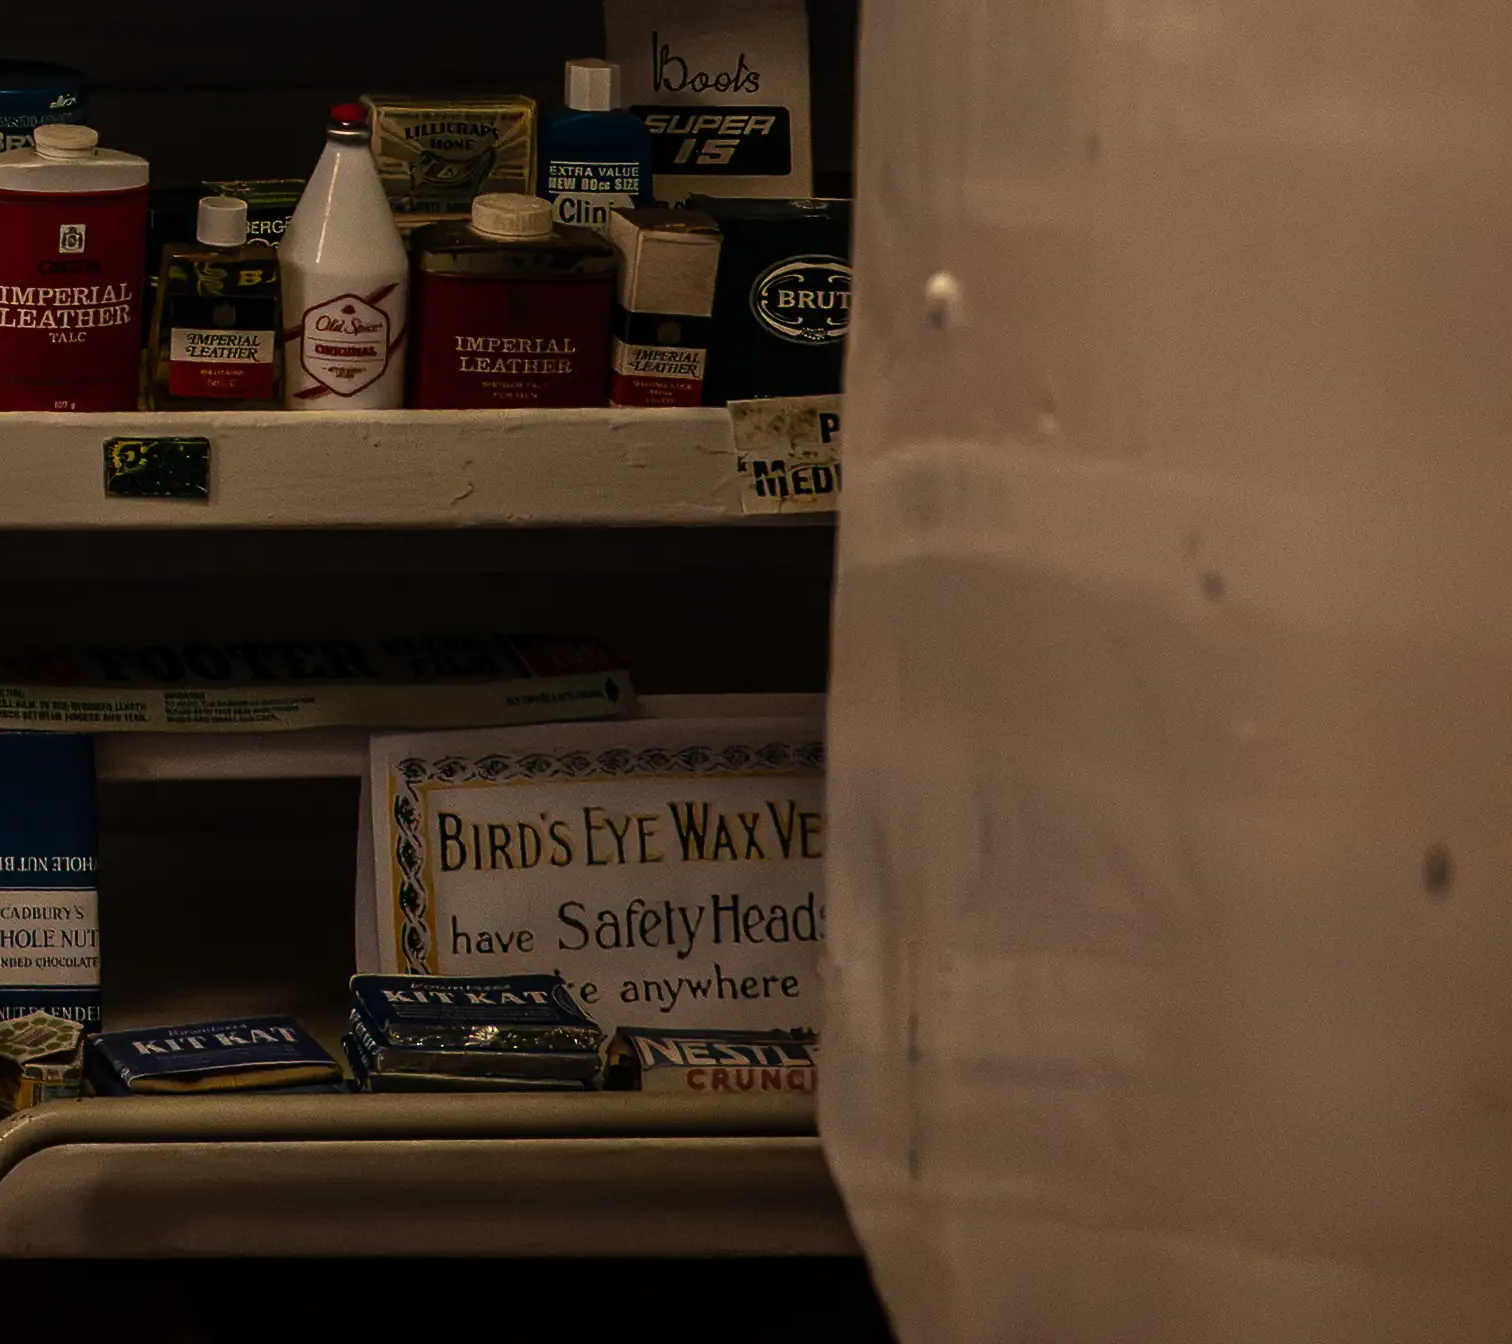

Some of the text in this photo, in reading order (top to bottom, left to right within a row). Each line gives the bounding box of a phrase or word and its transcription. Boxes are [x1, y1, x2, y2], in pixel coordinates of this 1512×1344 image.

[650, 30, 762, 96] Boots
[642, 113, 777, 137] SUPER
[672, 135, 740, 166] 15
[437, 800, 767, 874] BIRD'S EYE WAX
